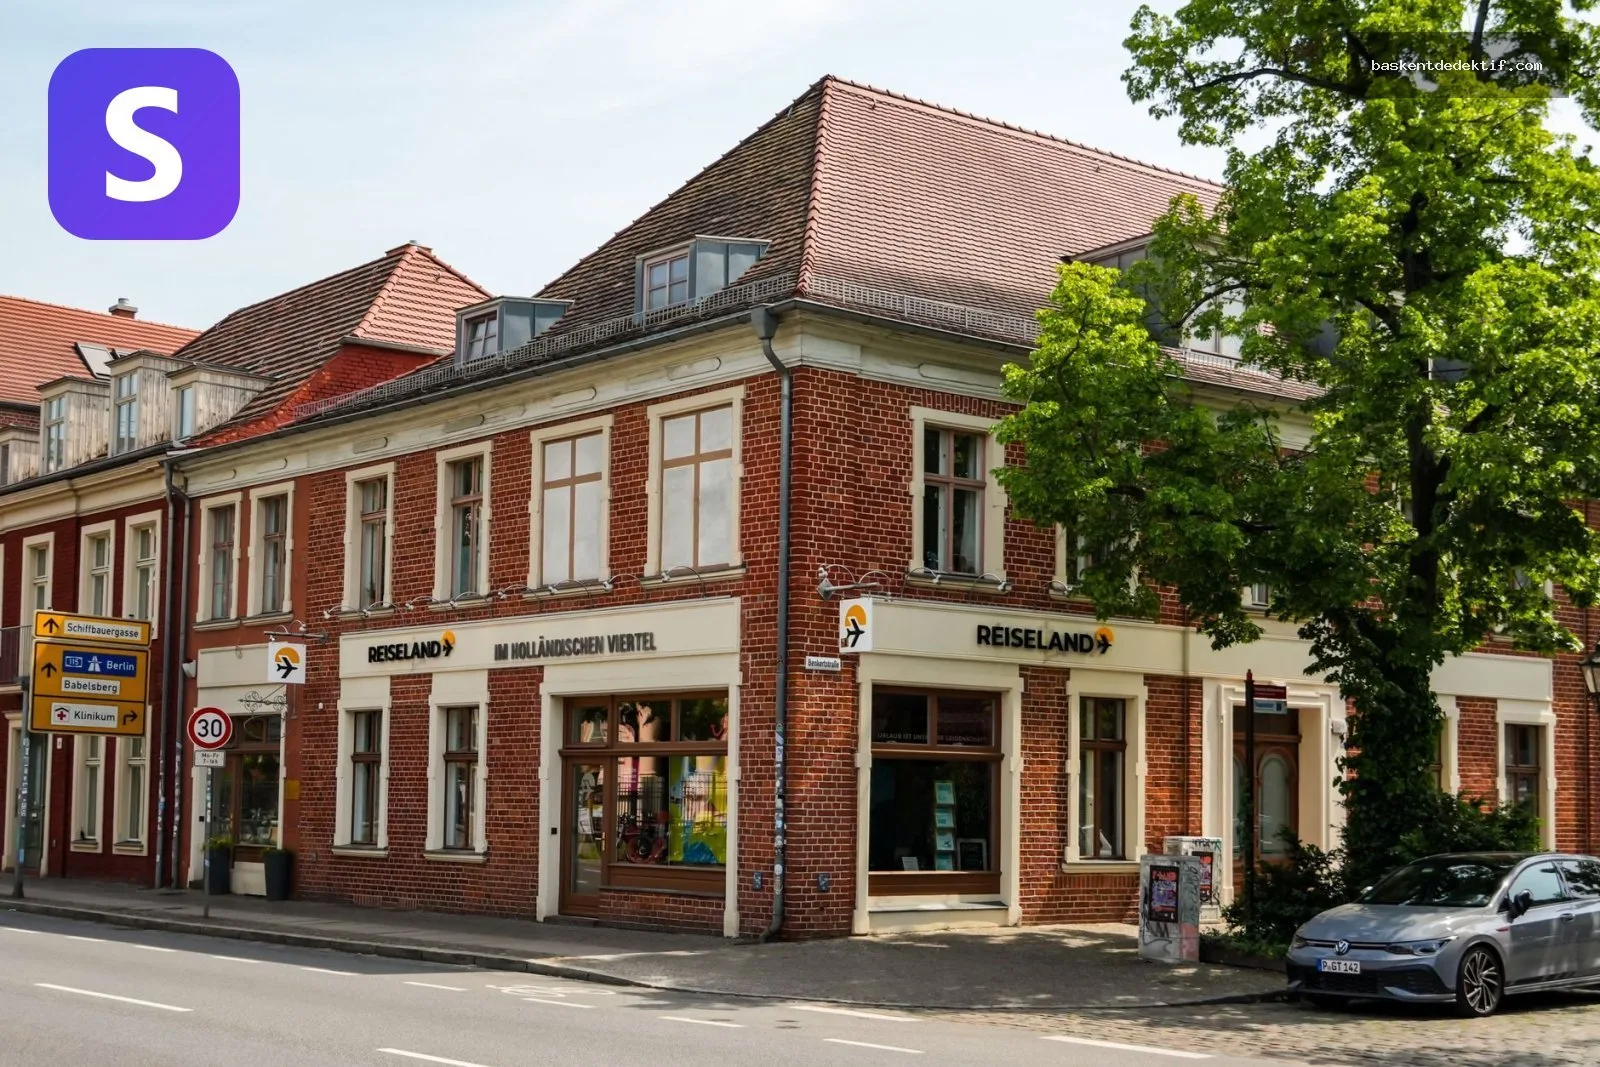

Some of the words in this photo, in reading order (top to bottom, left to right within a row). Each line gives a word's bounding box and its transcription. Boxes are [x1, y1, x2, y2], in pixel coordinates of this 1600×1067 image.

[67, 622, 139, 637] Schiffbauergasse
[494, 643, 508, 661] IM
[511, 636, 604, 660] HOLLÄNDISCHEN
[608, 632, 656, 654] VIERTEL
[976, 624, 1094, 654] REISELAND
[368, 640, 441, 663] REISELAND
[107, 660, 135, 671] Berlin
[64, 679, 118, 693] Babelsberg
[74, 709, 116, 722] Klinikum
[197, 719, 222, 738] 30
[1343, 963, 1359, 972] 142
